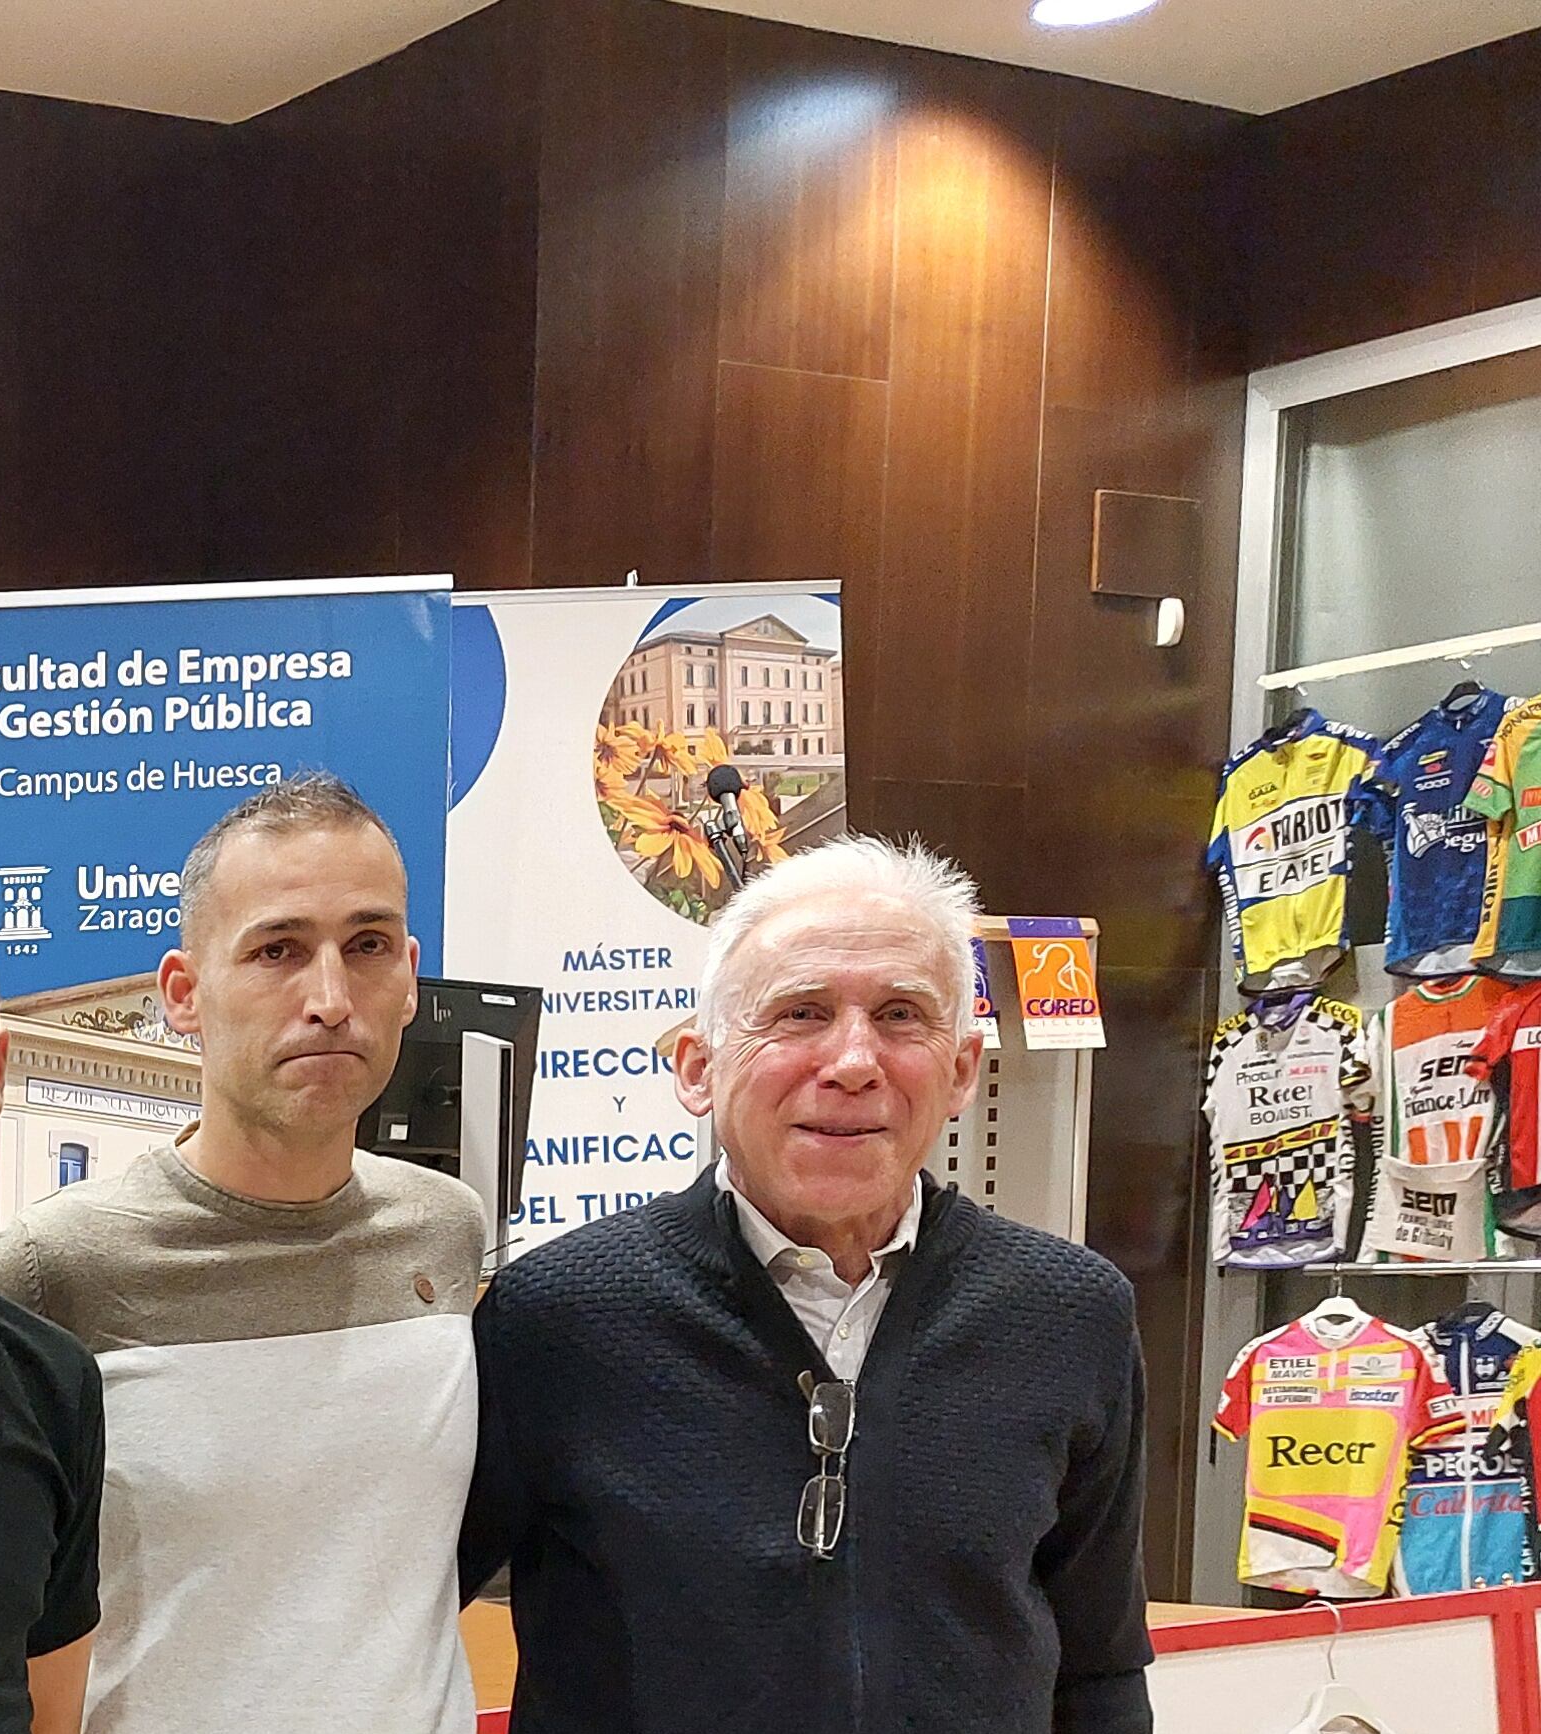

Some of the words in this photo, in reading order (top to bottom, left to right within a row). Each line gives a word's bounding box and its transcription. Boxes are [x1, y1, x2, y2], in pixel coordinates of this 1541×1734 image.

[116, 649, 168, 687] de
[179, 648, 352, 692] Empresa
[165, 693, 312, 733] Pública
[126, 761, 165, 791] de
[173, 758, 281, 790] Huesca
[6, 943, 38, 955] 1542
[562, 942, 672, 972] MÁSTER
[541, 988, 699, 1013] NIVERSITARI
[1026, 998, 1096, 1016] CORED
[541, 1047, 674, 1079] IRECCI
[139, 1101, 201, 1120] PROVINCI
[613, 1096, 626, 1113] Y
[525, 1132, 695, 1166] ANIFICAC
[1269, 1358, 1316, 1369] ETIEL
[1270, 1370, 1314, 1379] MAVIC
[1267, 1435, 1376, 1469] Recer
